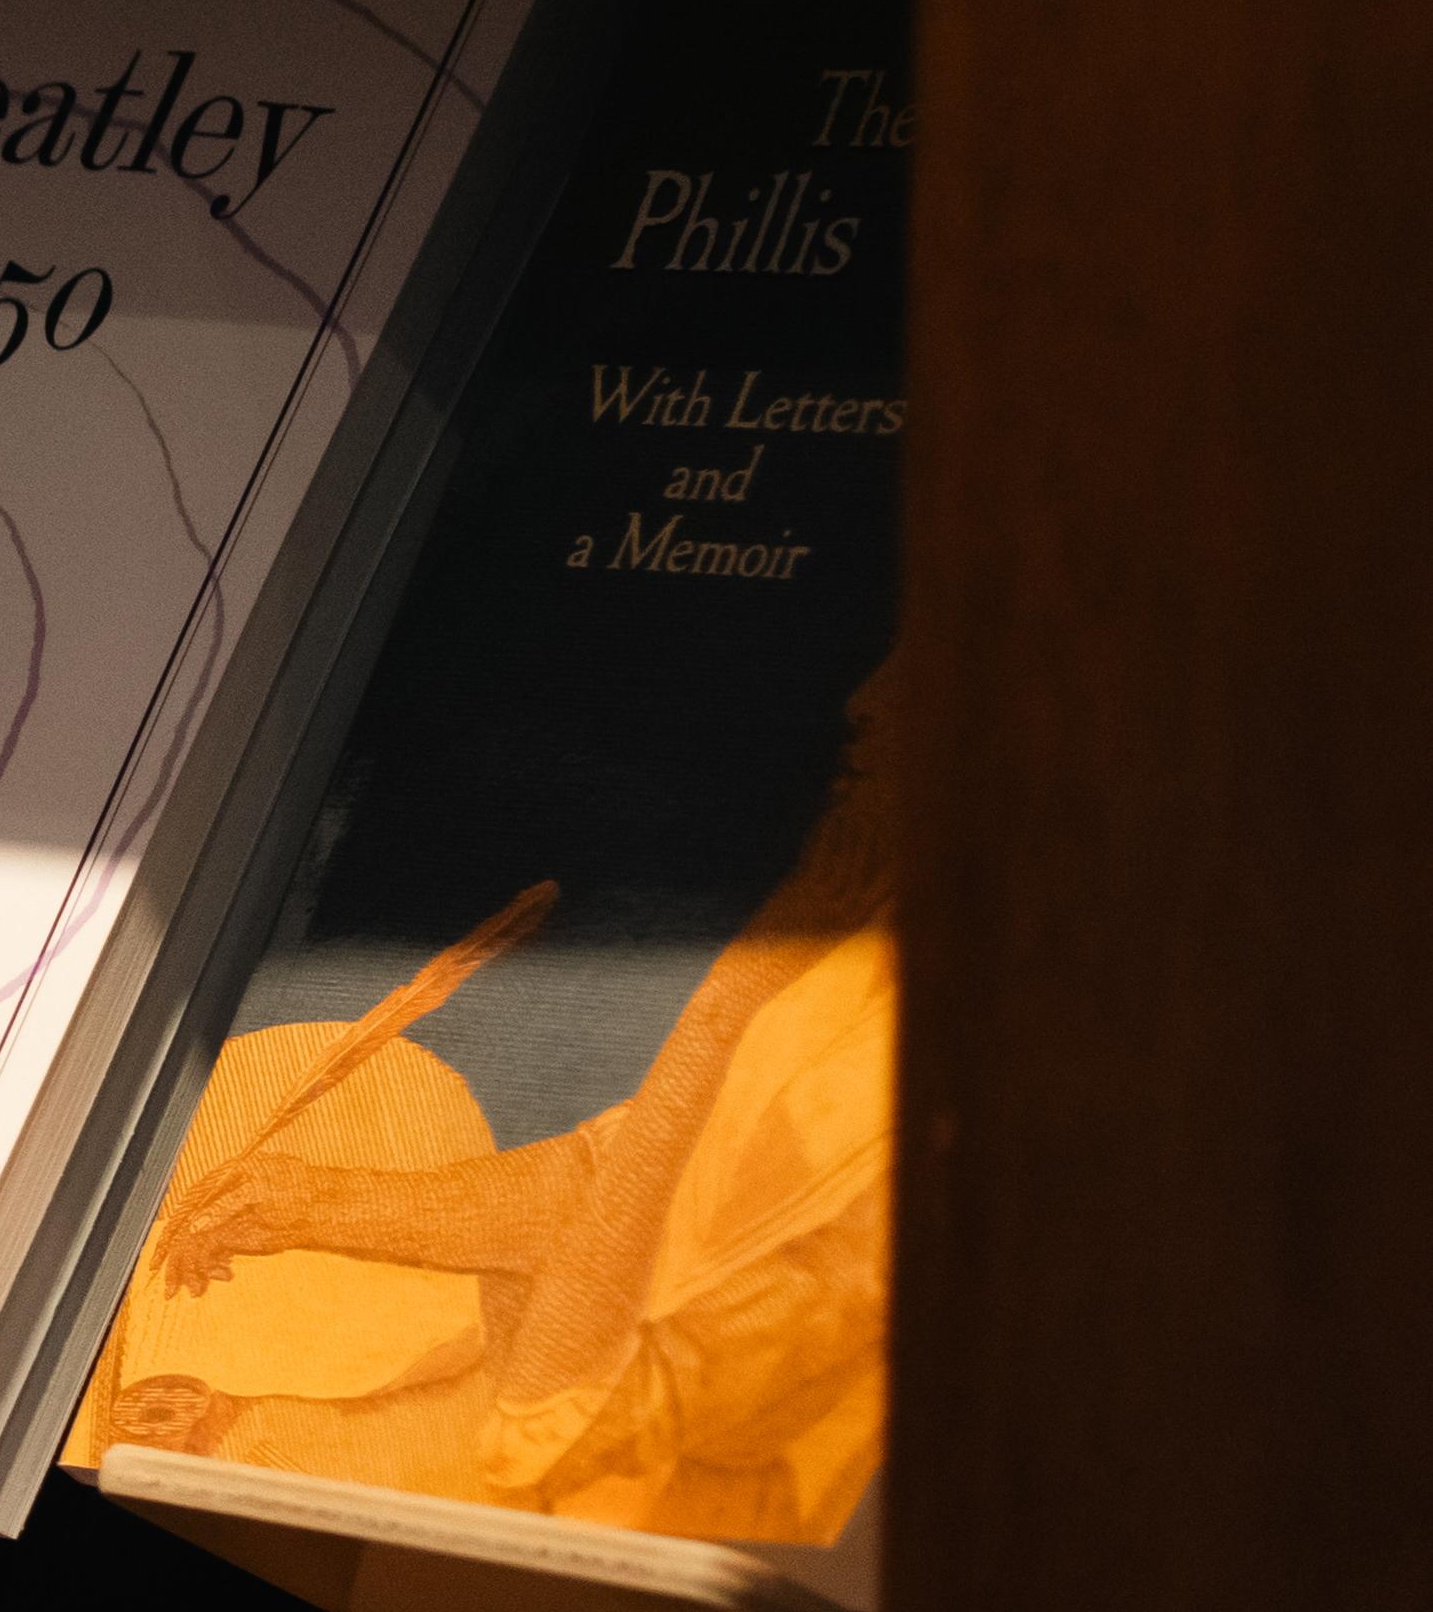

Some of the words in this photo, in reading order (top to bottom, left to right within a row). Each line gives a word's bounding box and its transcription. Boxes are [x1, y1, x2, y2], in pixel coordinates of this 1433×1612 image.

[810, 67, 919, 150] The
[608, 167, 863, 278] Phillis
[587, 362, 712, 427] With
[724, 368, 910, 438] Letters
[662, 442, 767, 504] and
[565, 530, 596, 570] a
[605, 510, 812, 581] Memoir
